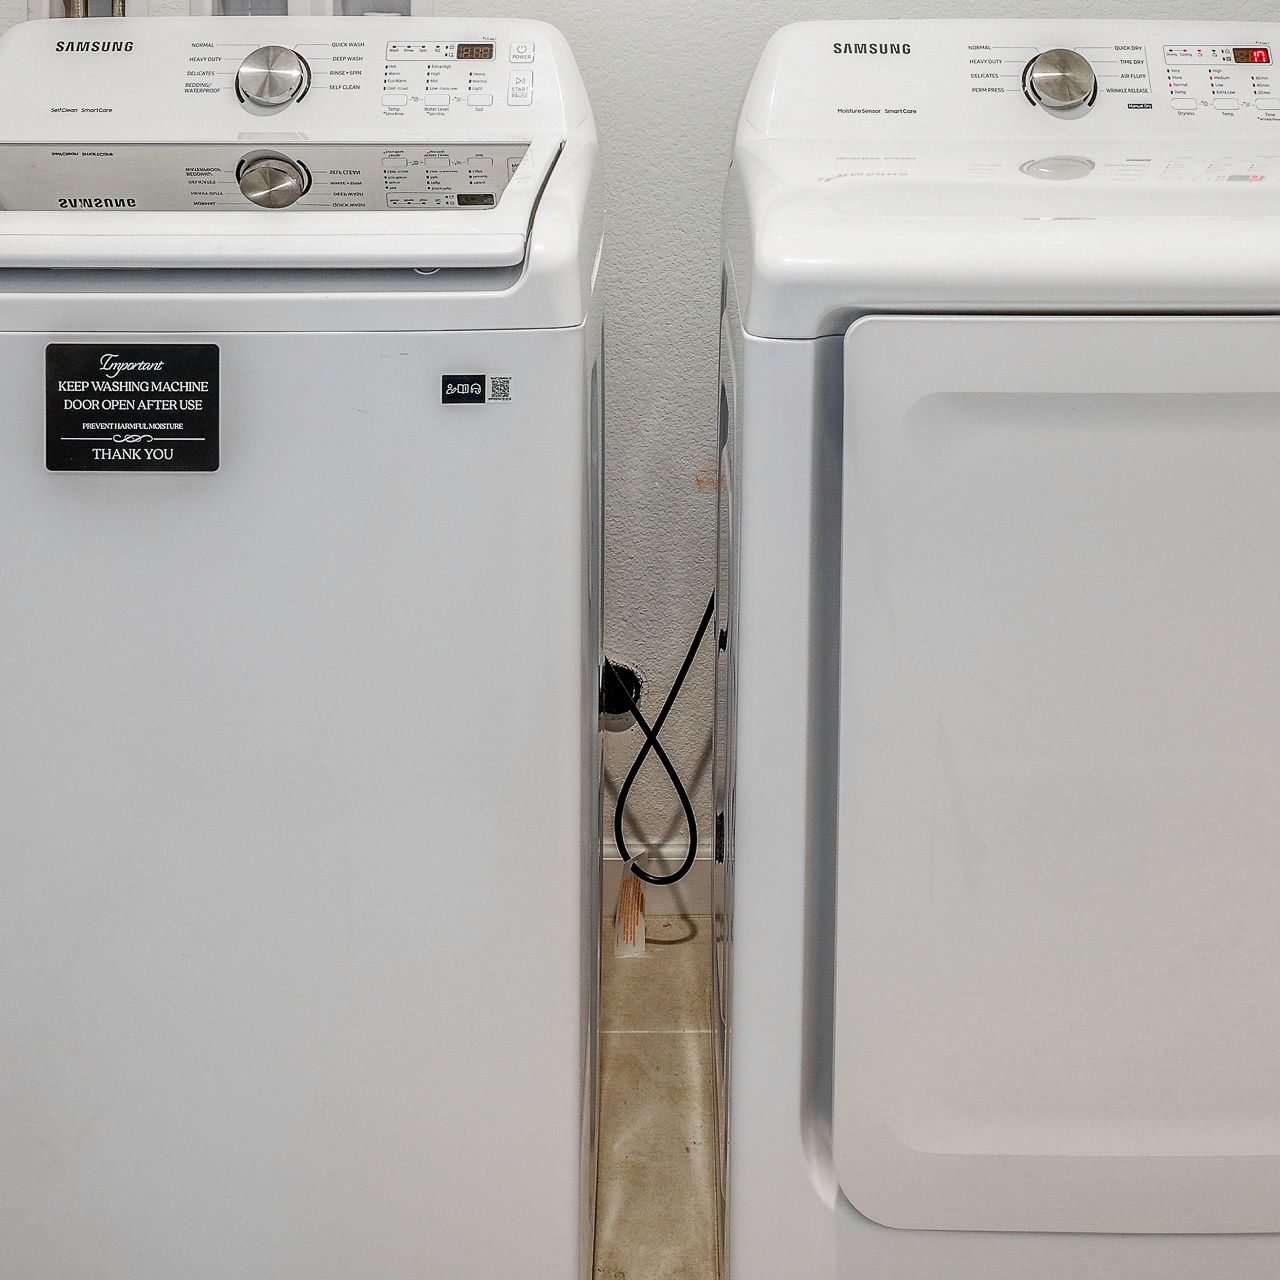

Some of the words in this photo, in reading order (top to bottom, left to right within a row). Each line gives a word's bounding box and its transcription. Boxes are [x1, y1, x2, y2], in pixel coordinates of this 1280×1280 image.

[55, 41, 134, 52] SAMSUNG
[833, 43, 911, 54] SAMSUNG
[99, 353, 165, 379] Important
[58, 381, 90, 392] KEEP
[91, 381, 150, 392] WASHING
[151, 381, 209, 392] MACHINE
[63, 399, 100, 411] DOOR
[101, 399, 135, 411] OPEN
[136, 399, 178, 411] AFTER
[179, 399, 203, 411] USE
[82, 422, 115, 430] PREVENT
[115, 422, 149, 430] HARMFUL
[149, 422, 184, 430] MOISTURE
[92, 448, 142, 460] THANK
[144, 448, 174, 460] YOU
